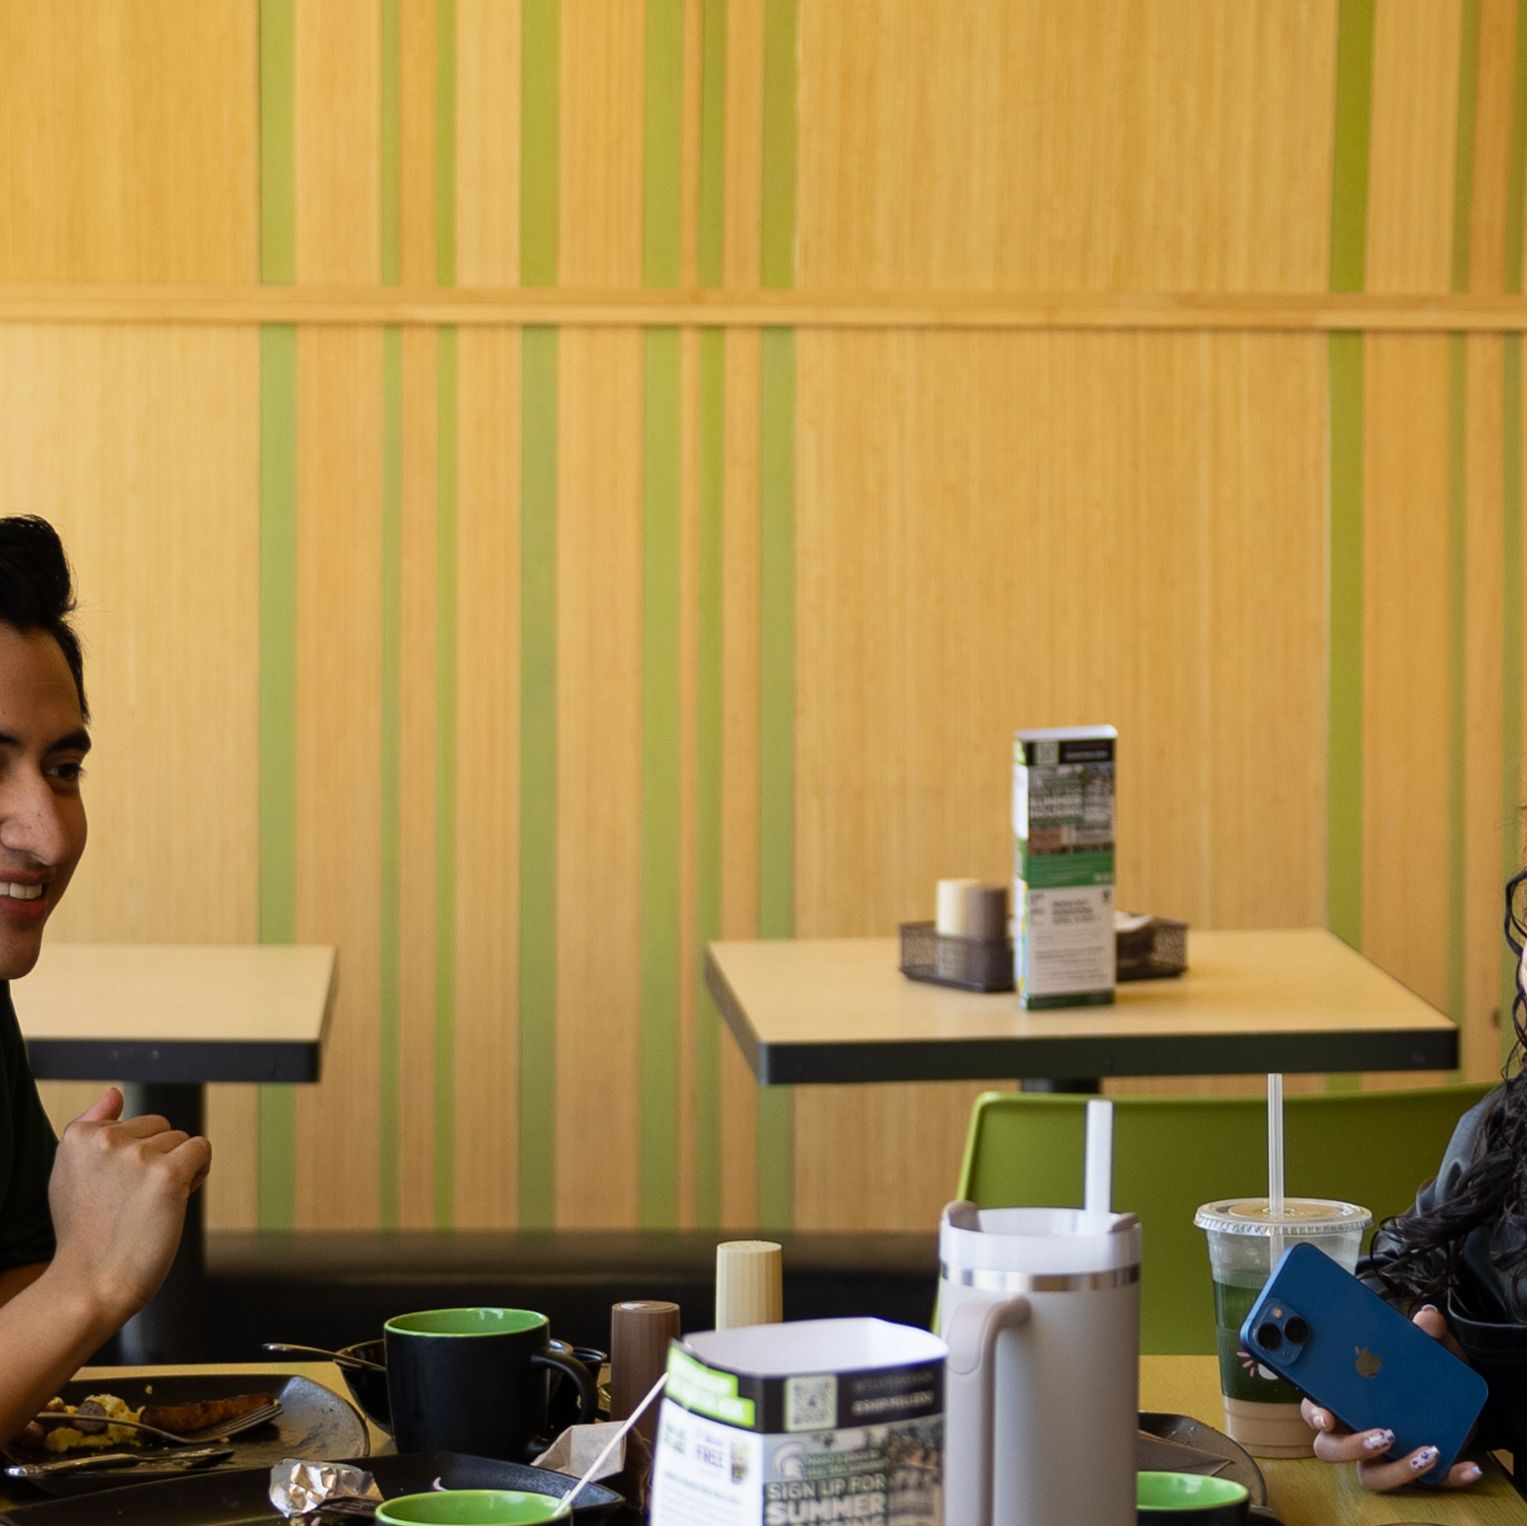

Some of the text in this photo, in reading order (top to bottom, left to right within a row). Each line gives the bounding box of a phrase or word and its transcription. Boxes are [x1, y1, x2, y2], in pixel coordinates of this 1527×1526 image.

[696, 1443, 724, 1469] FREE
[767, 1473, 886, 1500] SIGN UP FOR
[766, 1492, 886, 1524] SUMMER
